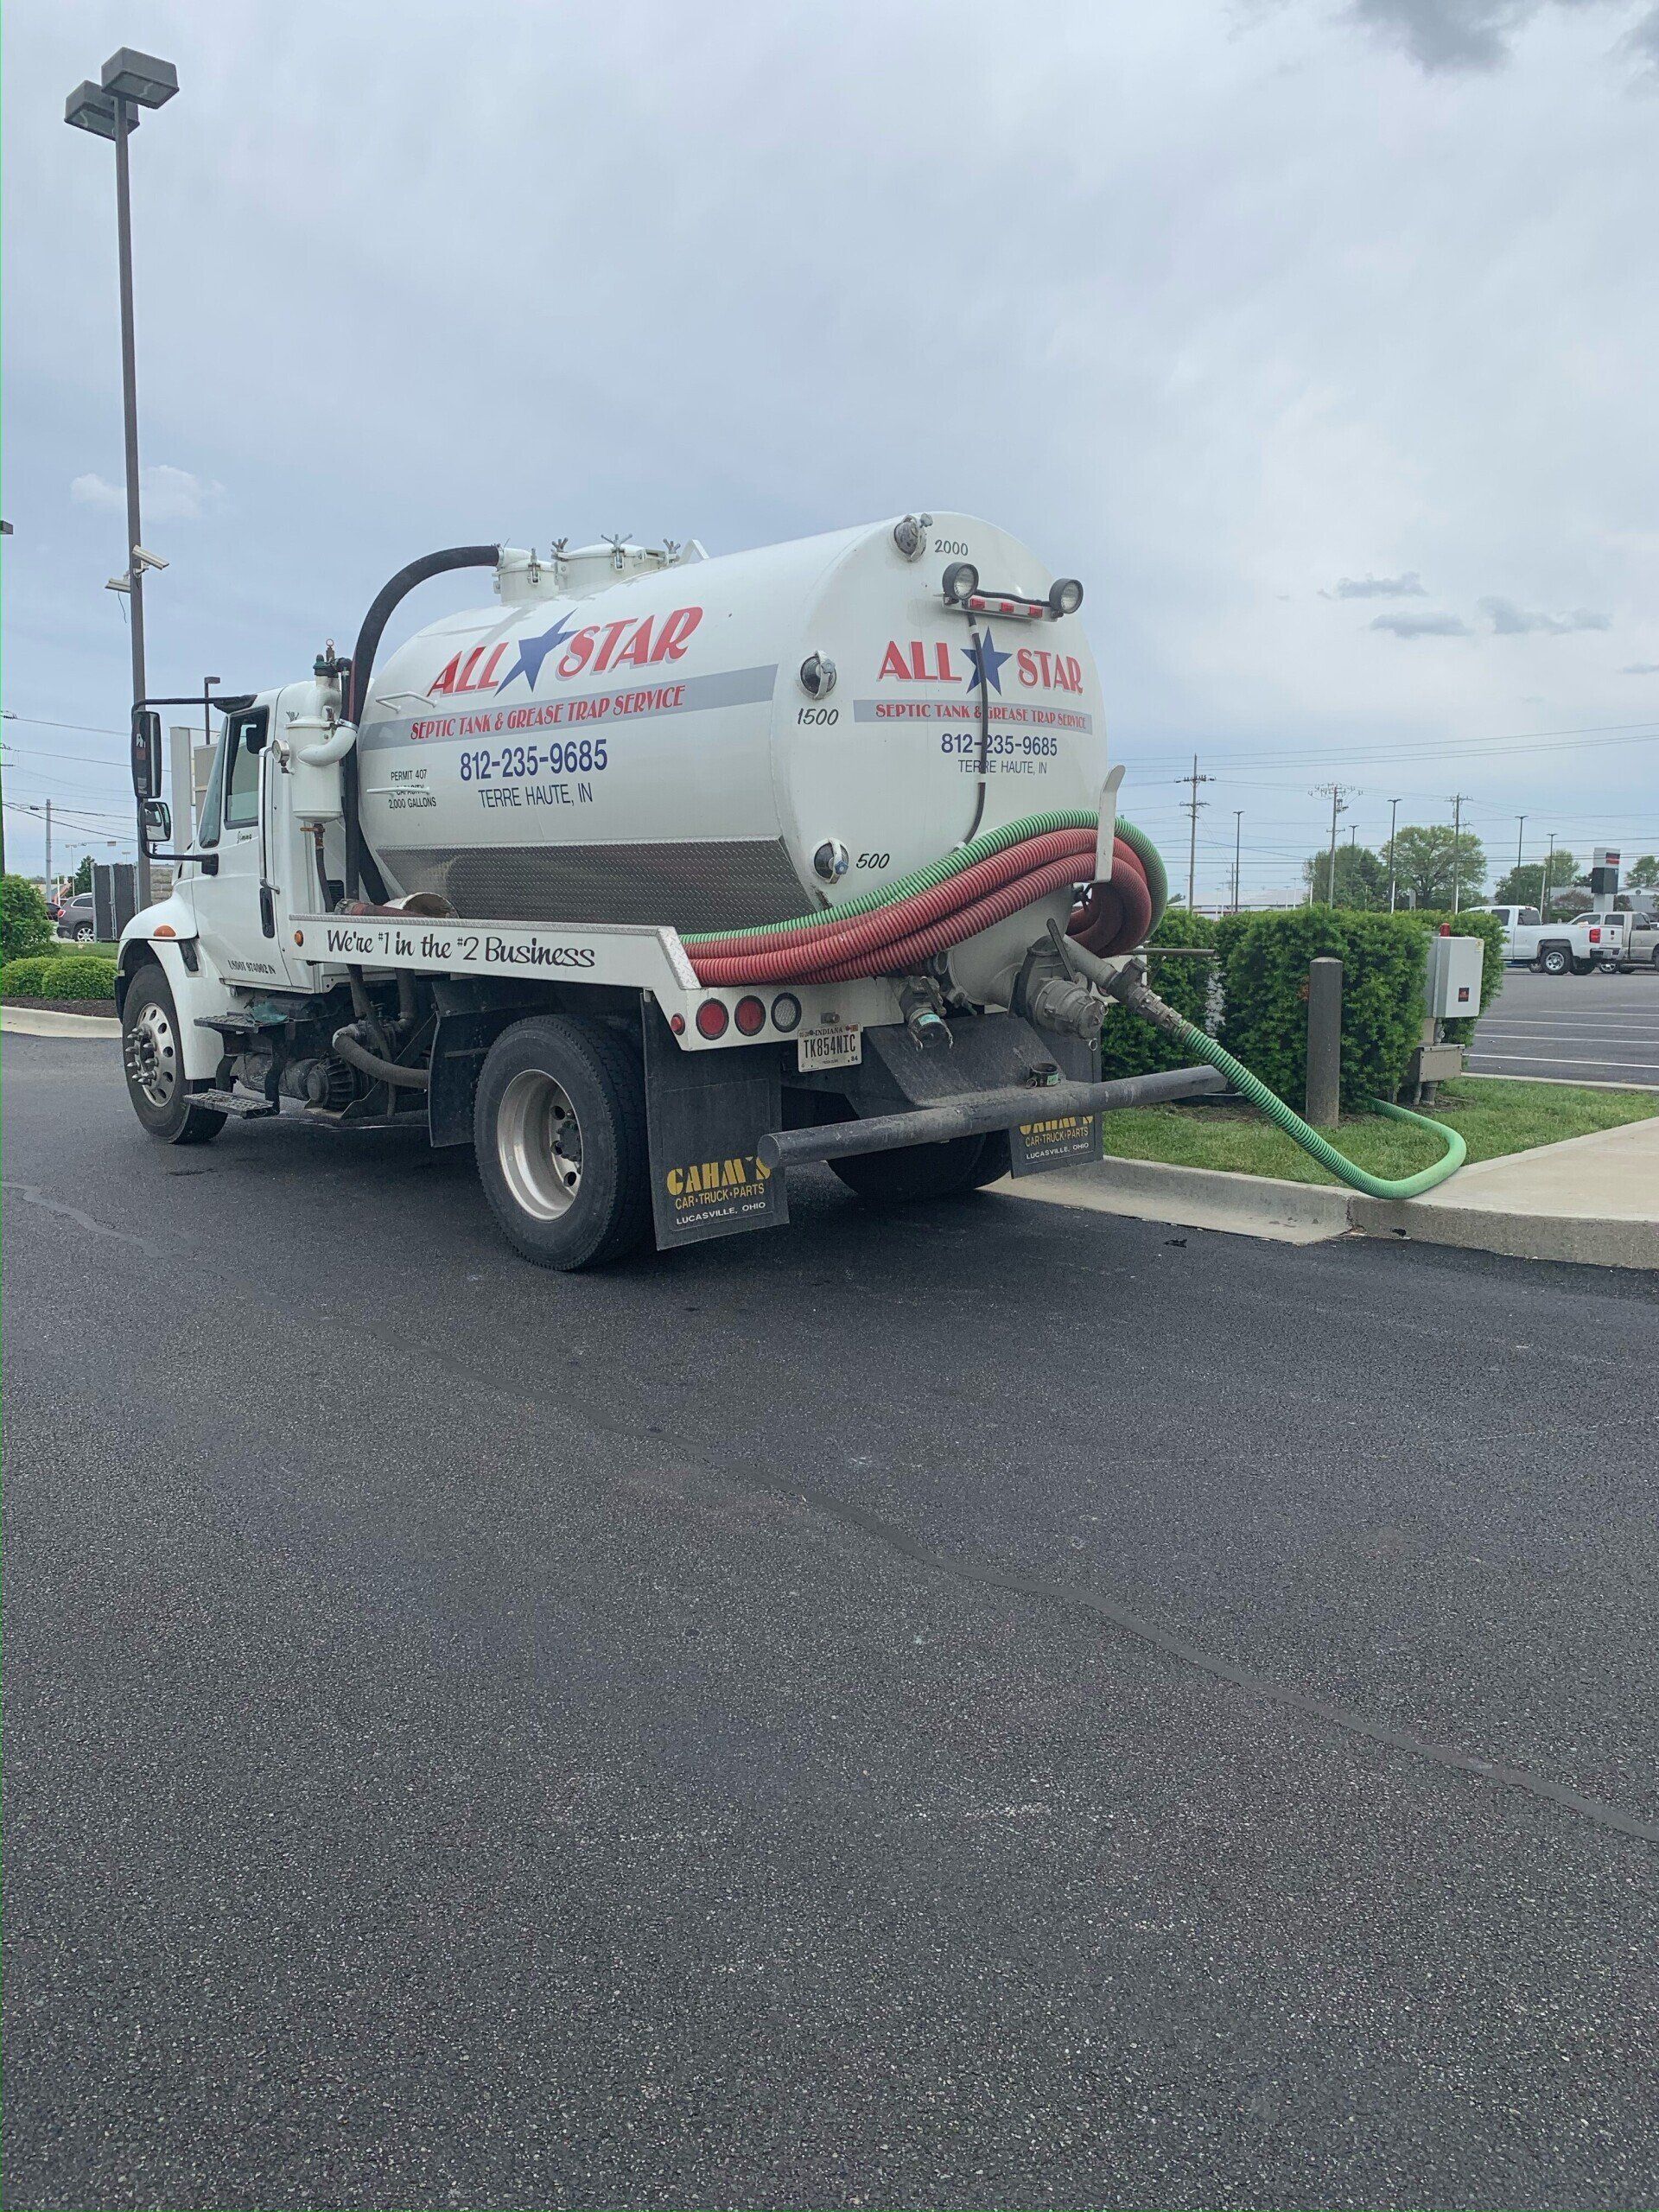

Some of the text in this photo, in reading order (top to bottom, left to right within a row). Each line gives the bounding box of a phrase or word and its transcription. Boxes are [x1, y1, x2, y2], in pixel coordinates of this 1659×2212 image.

[934, 539, 969, 556] 2000
[425, 606, 703, 697] ALL STAR
[876, 640, 1084, 695] ALL STAR
[410, 684, 686, 741] SEPTIC TANK & GREASE TRAP SERVICE
[797, 708, 839, 726] 1500
[875, 703, 931, 718] SEPTIC
[934, 704, 970, 718] TANK
[974, 705, 982, 719] &
[1031, 709, 1056, 724] TRAP
[1057, 713, 1086, 729] SERVICE
[941, 733, 1058, 756] 812-235-9685
[460, 738, 607, 781] 812-235-9685
[1001, 760, 1036, 775] HAUTE,
[1039, 761, 1047, 774] IN
[391, 769, 428, 781] PERMIT 407
[407, 797, 437, 809] GALLONS
[478, 782, 594, 809] TERRE HAUTE, IN
[855, 853, 890, 869] 500
[327, 929, 596, 968] We're #1 in the #2 Business
[815, 1027, 843, 1036] INDIANA
[804, 1033, 855, 1058] TK854NIC
[1072, 1142, 1090, 1151] OHIO
[676, 1201, 766, 1225] LUCASVILLE, OHIO
